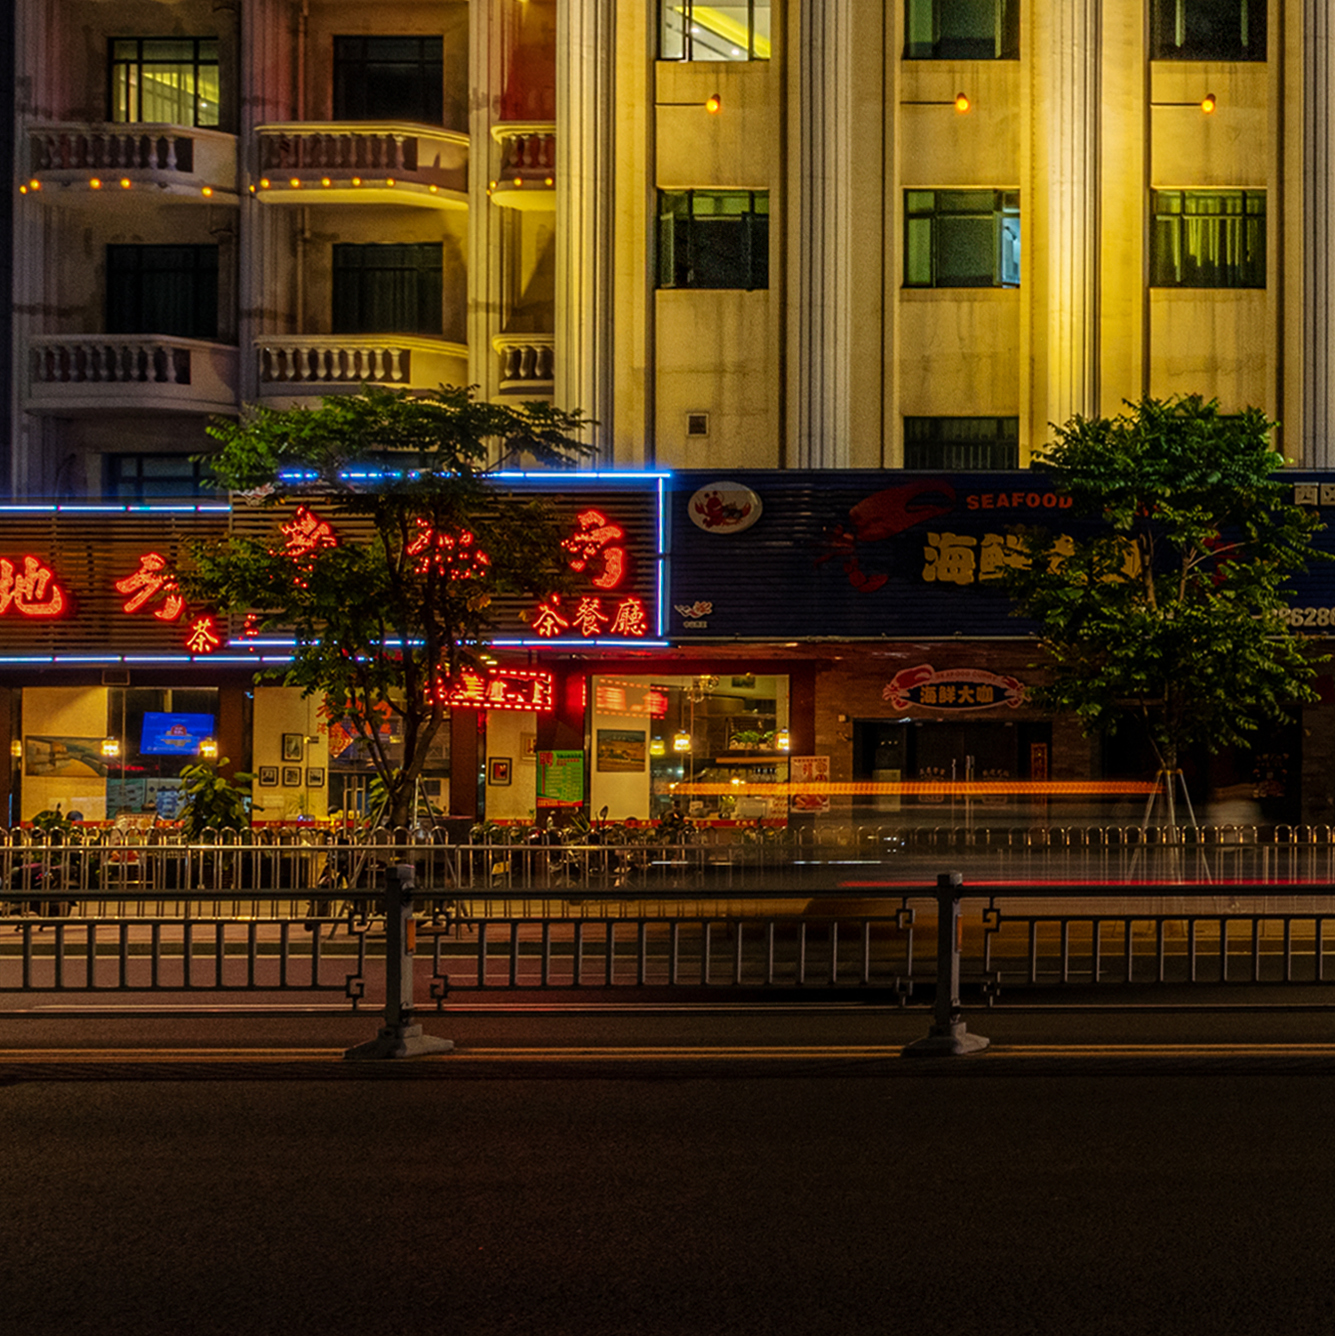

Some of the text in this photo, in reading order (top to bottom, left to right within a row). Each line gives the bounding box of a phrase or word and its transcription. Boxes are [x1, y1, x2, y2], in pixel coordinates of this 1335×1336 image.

[966, 492, 1073, 510] SEAFOOD
[532, 594, 648, 637] 茶餐廳
